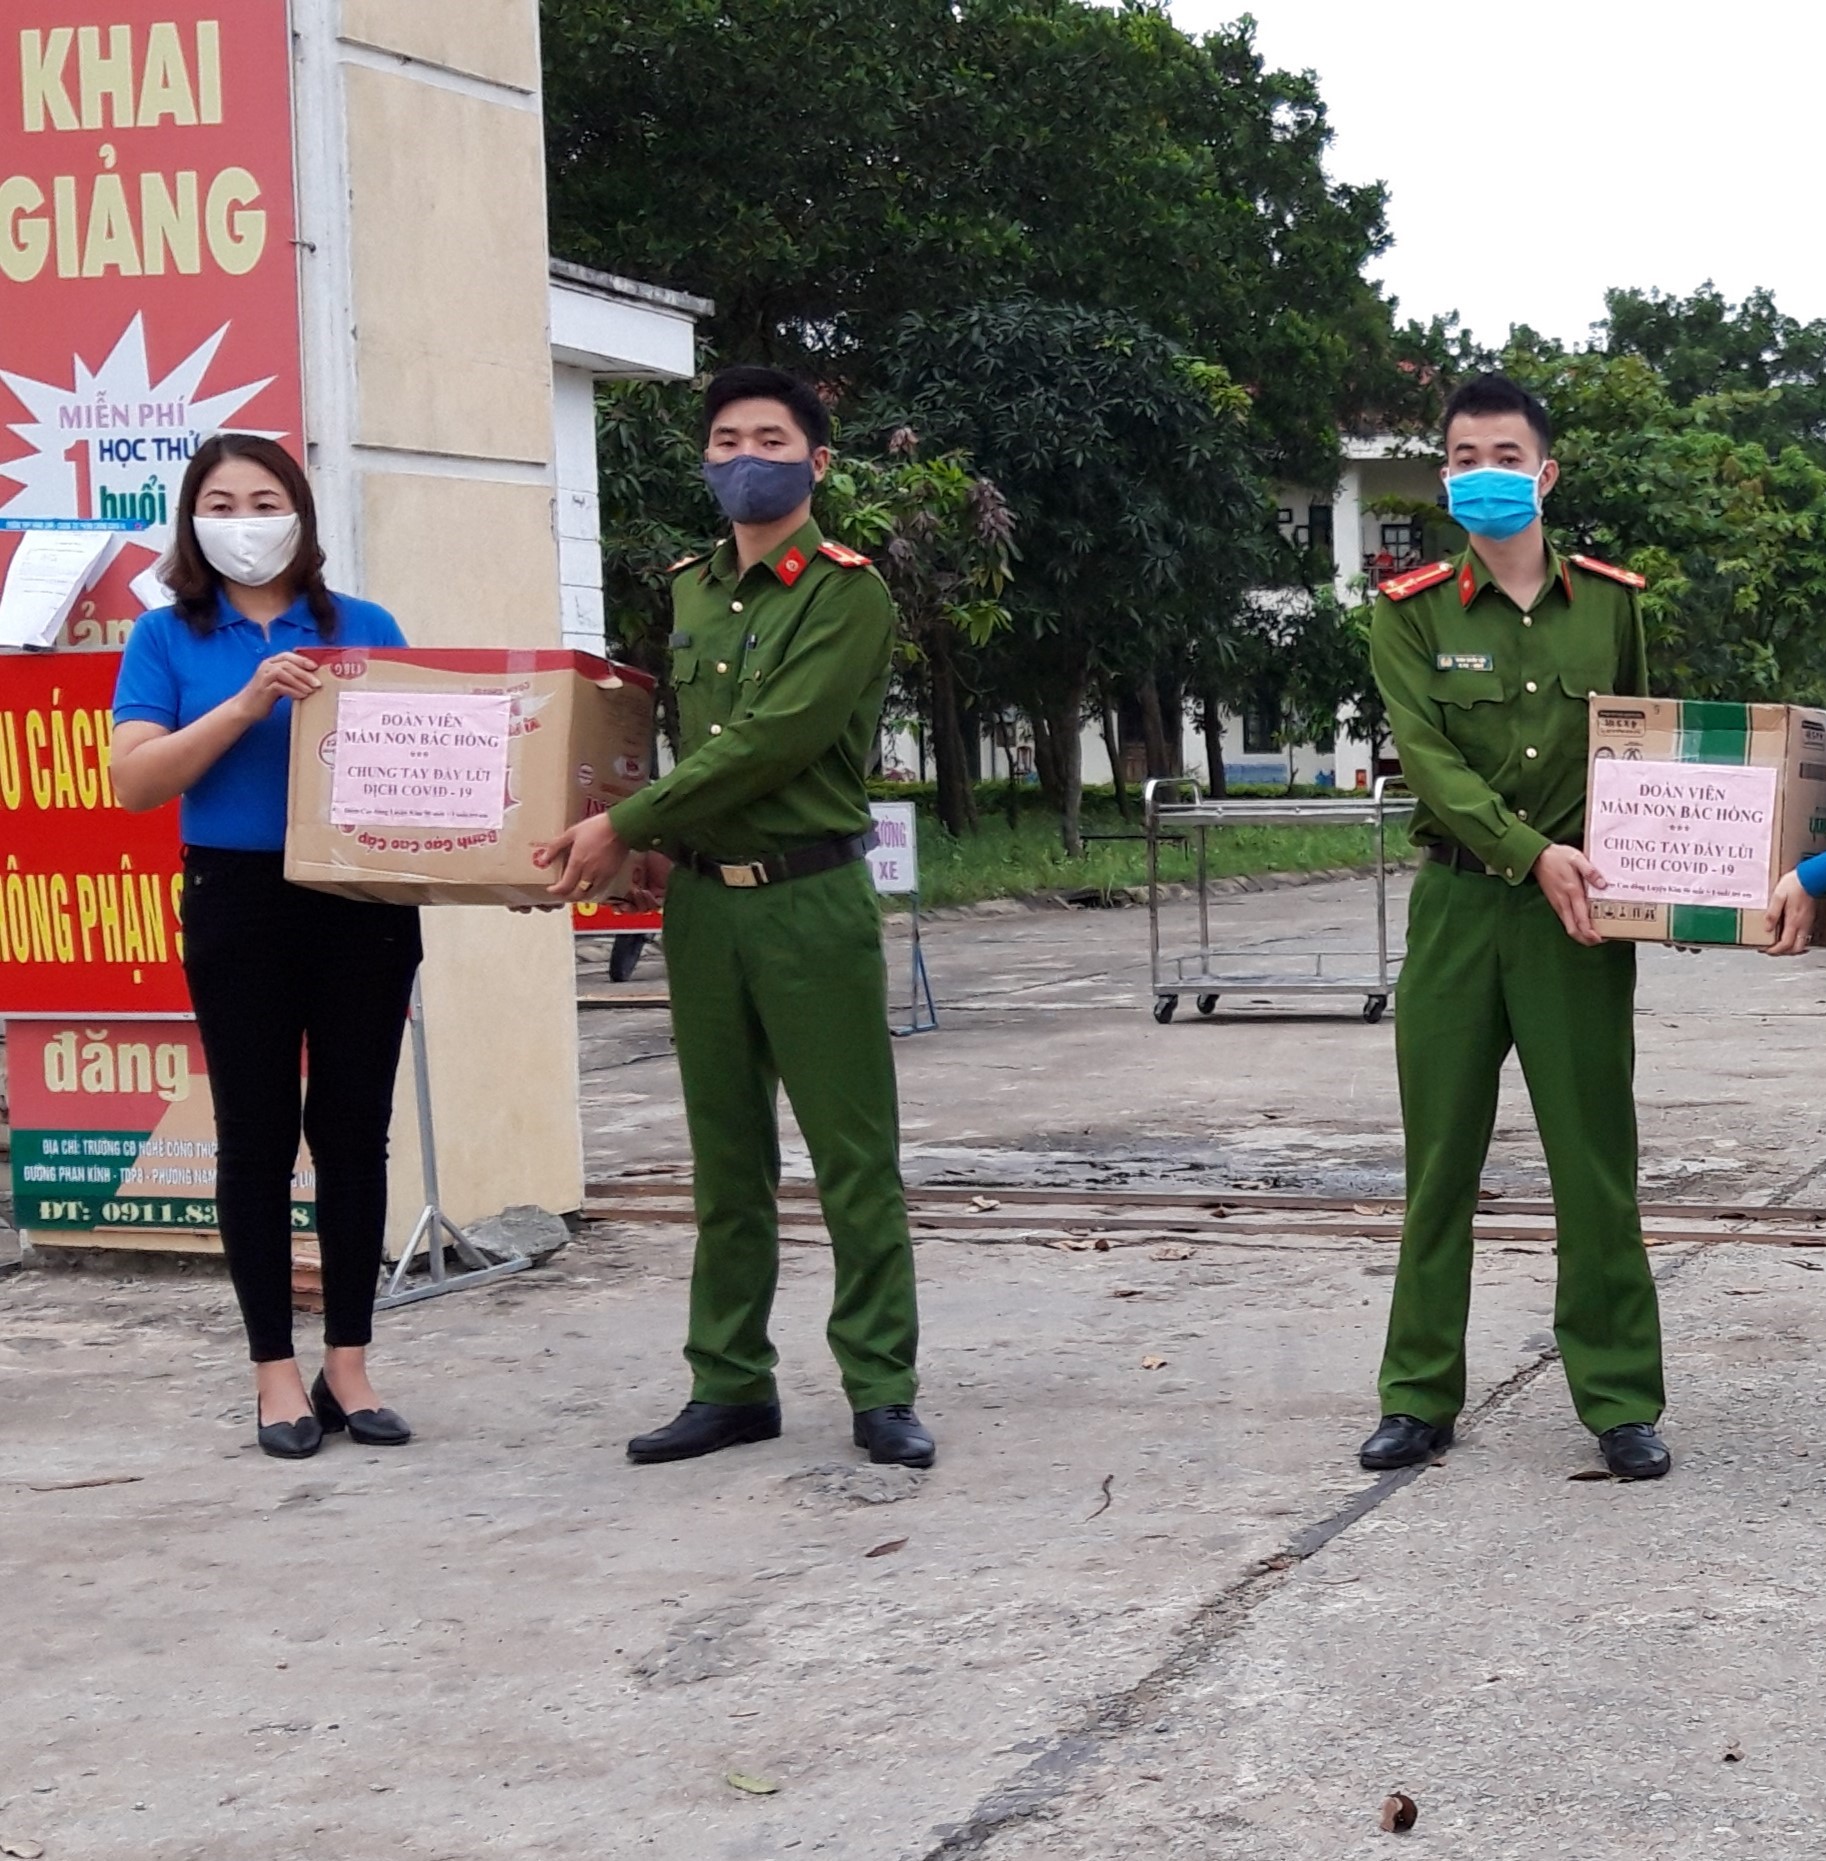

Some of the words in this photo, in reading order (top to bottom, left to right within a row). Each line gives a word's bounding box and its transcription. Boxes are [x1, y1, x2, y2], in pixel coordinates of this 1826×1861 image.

[20, 20, 222, 132] KHAI
[0, 143, 266, 282] GIẢNG
[59, 390, 130, 429] MIỄN
[138, 395, 185, 427] PHÍ
[63, 439, 93, 519] 1
[99, 438, 147, 468] HỌC
[381, 711, 424, 727] ĐOÀN
[429, 712, 463, 728] VIÊN
[384, 732, 416, 746] NON
[347, 766, 397, 779] CHUNG
[401, 767, 430, 780] TAY
[363, 783, 398, 798] DỊCH
[401, 784, 449, 798] COVID
[459, 786, 473, 798] 19
[1639, 781, 1684, 799] ĐOÀN
[1689, 784, 1727, 801] VIÊN
[1643, 804, 1676, 818] NON
[1603, 837, 1656, 853] CHUNG
[1660, 840, 1690, 855] TAY
[879, 861, 899, 880] XE
[1620, 856, 1657, 872] DỊCH
[1660, 860, 1709, 875] COVID
[1721, 866, 1735, 877] 19
[76, 854, 168, 985] PHẬN
[43, 1028, 191, 1102] đăng
[58, 1166, 85, 1182] PHAN
